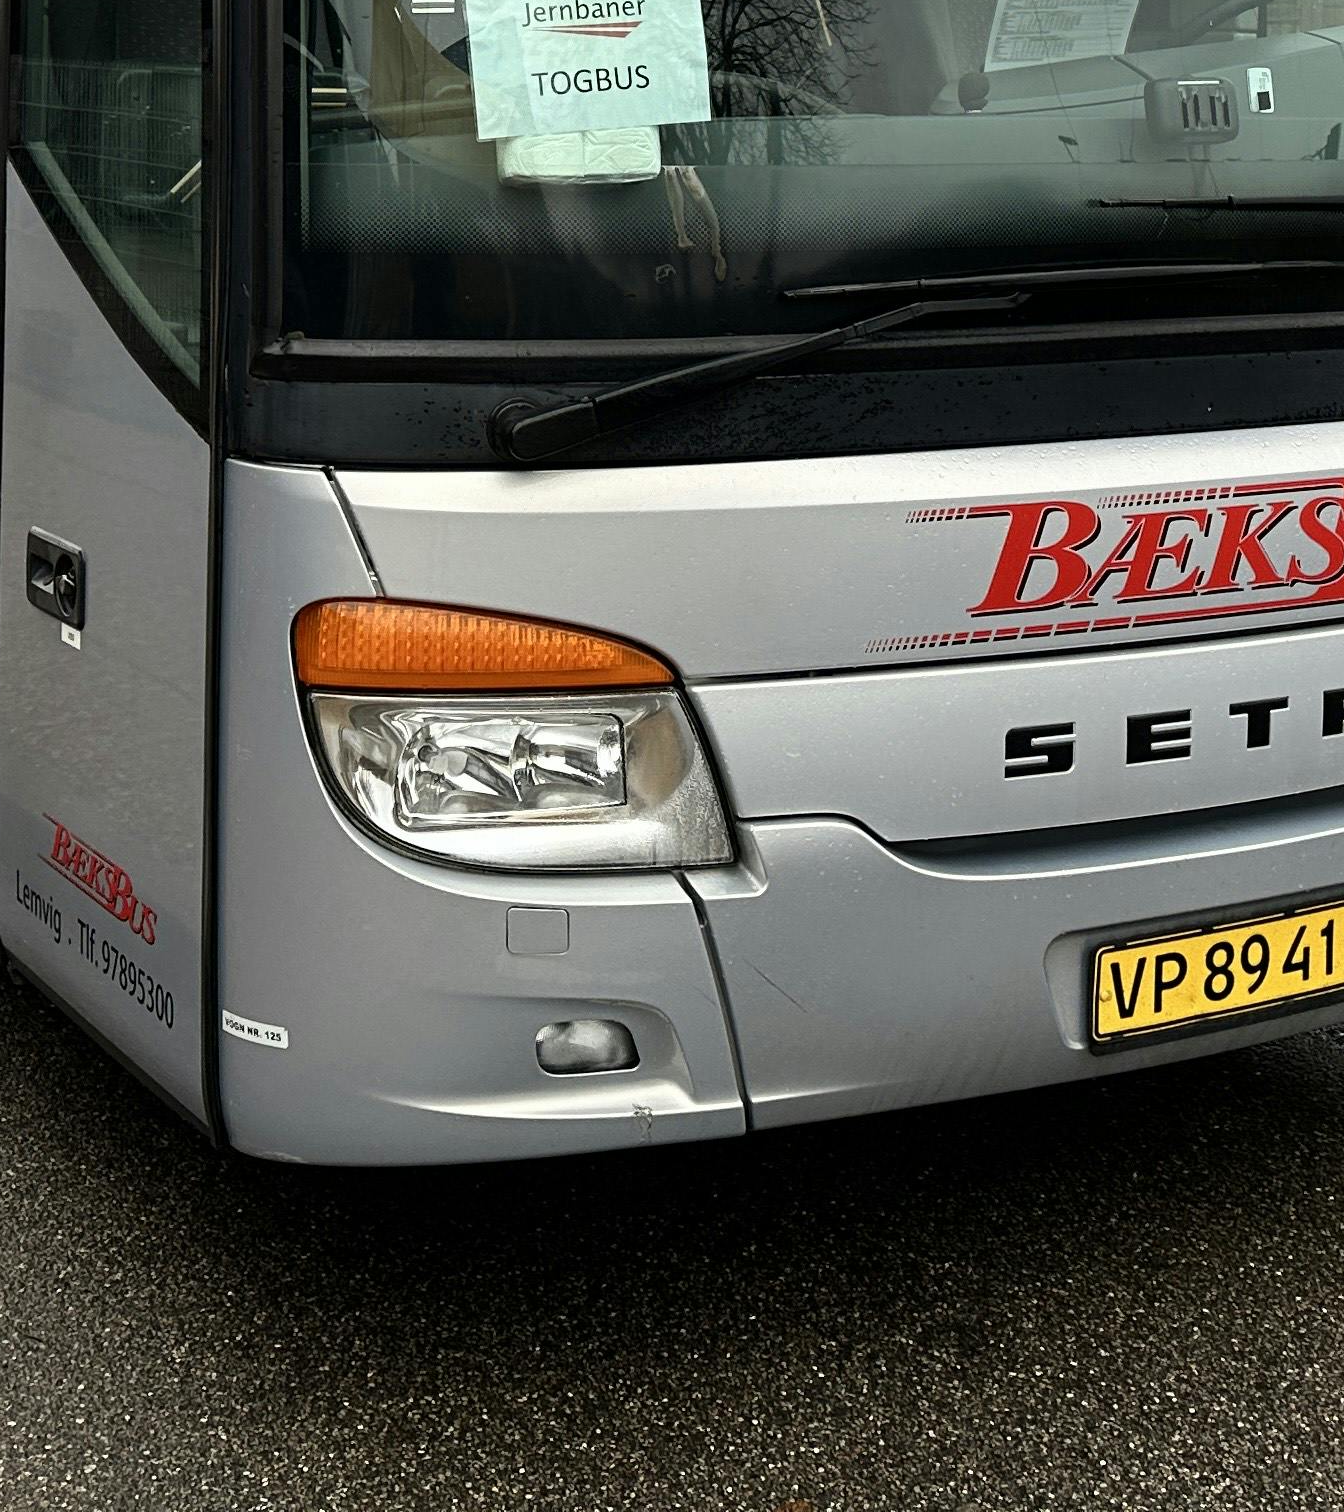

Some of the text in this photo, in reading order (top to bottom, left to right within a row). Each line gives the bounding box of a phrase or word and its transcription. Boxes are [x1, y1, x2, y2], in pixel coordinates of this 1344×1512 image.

[531, 64, 651, 97] TOGBUS
[16, 869, 62, 944] Lemvig
[1109, 953, 1189, 1019] VP
[265, 1031, 282, 1042] 125
